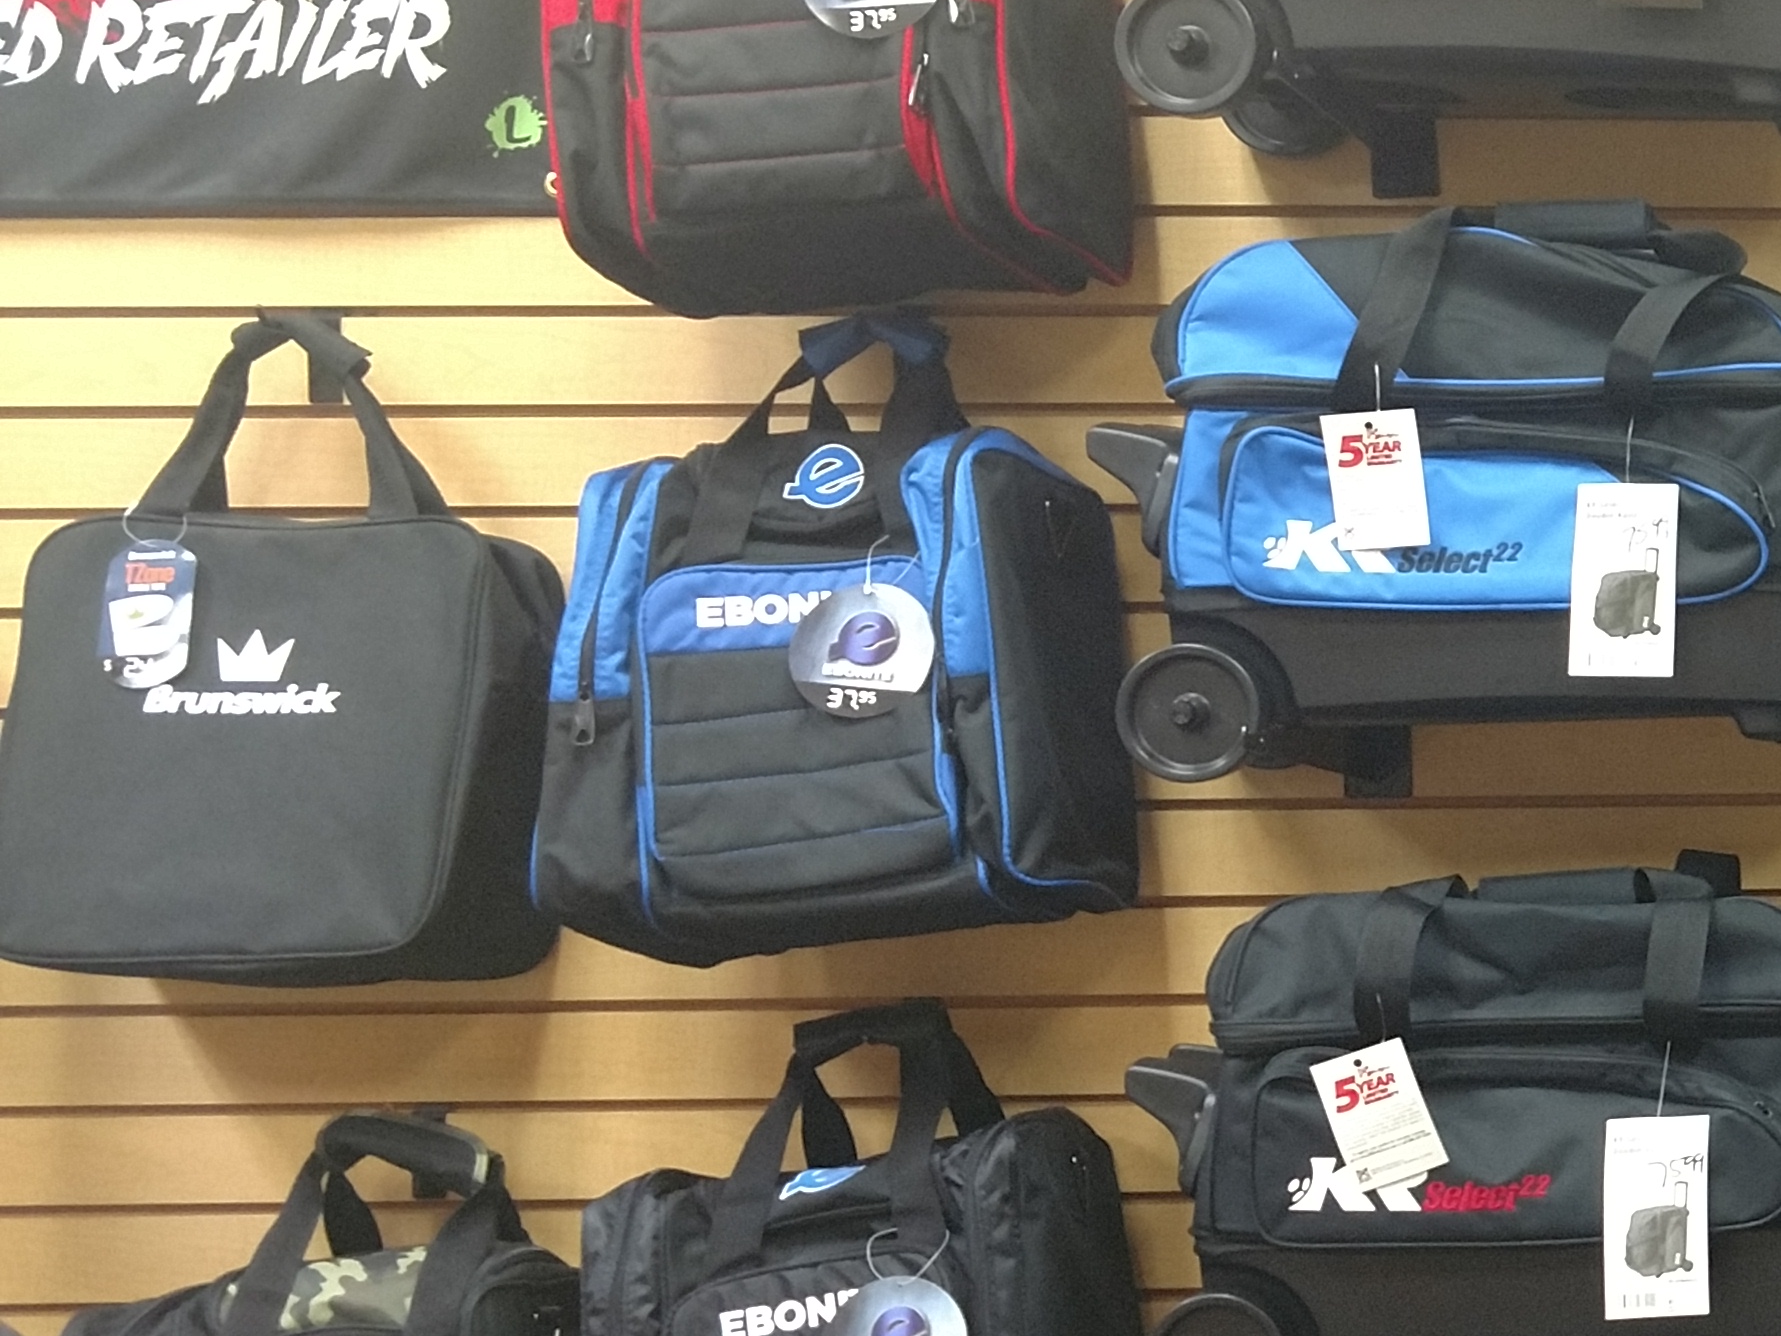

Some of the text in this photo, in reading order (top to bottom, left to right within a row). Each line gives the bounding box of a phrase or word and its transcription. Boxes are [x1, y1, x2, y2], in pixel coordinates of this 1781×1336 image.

[1338, 435, 1363, 467] 5
[1362, 441, 1401, 454] YEAR
[696, 590, 832, 628] EBON
[143, 683, 341, 714] Brunswick
[1335, 1072, 1396, 1113] 5 YEAR
